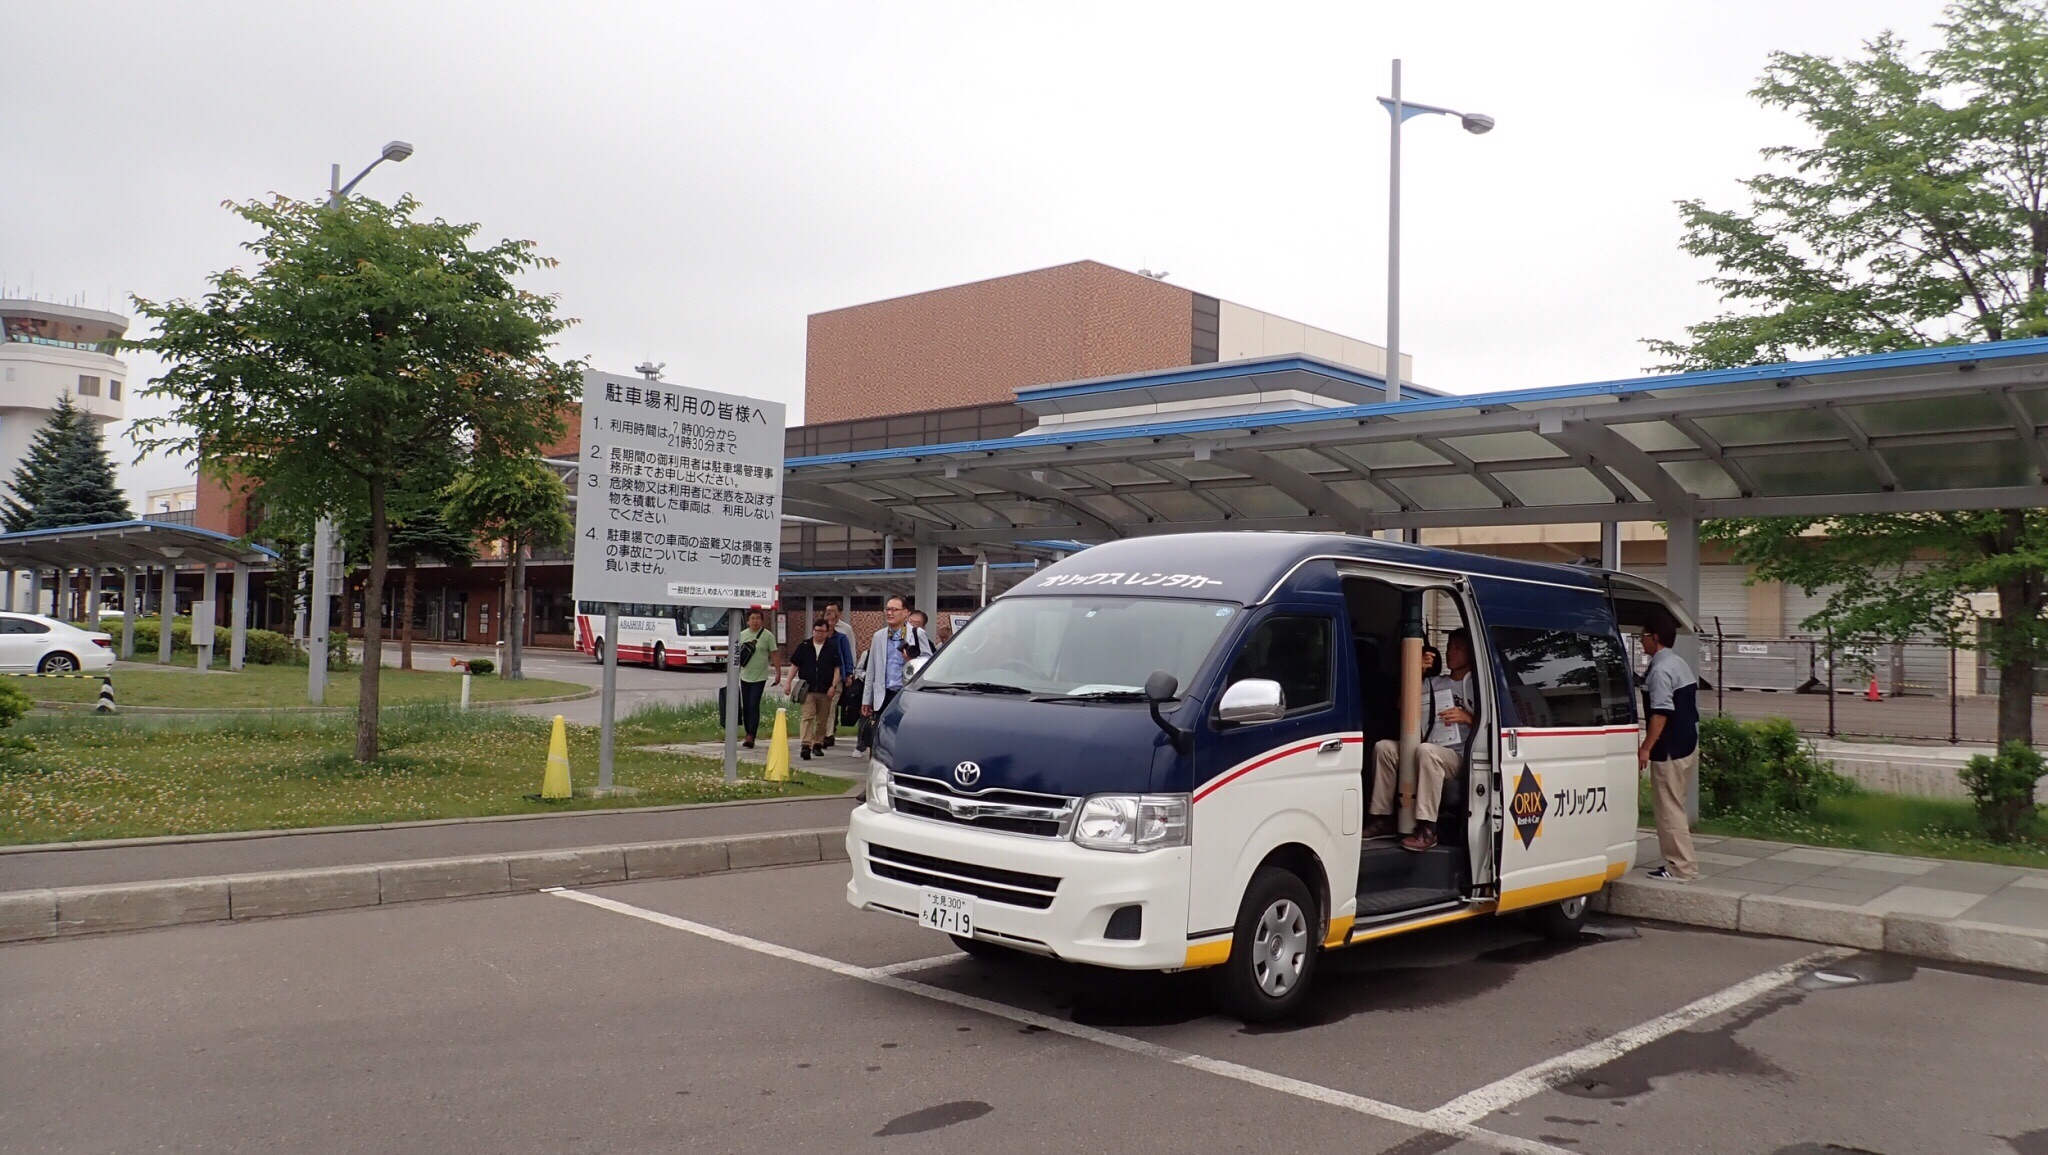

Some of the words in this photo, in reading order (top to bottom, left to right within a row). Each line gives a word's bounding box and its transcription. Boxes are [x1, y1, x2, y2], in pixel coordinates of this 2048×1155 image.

[605, 383, 767, 425] 駐車場利用の皆様へ
[609, 418, 668, 439] 利用時間は
[667, 433, 738, 456] 21時30分まで
[609, 460, 739, 489] 務所までお申し出ください。
[610, 447, 774, 480] 長期間の御利用者は駐車場管理事
[722, 502, 775, 521] 利用しない
[606, 528, 773, 554] 駐車場での車両の盗難又は損傷等
[709, 552, 773, 569] 一切の責任を
[1514, 791, 1542, 814] ORIX
[1554, 787, 1607, 817] オリックス
[947, 897, 962, 909] 300
